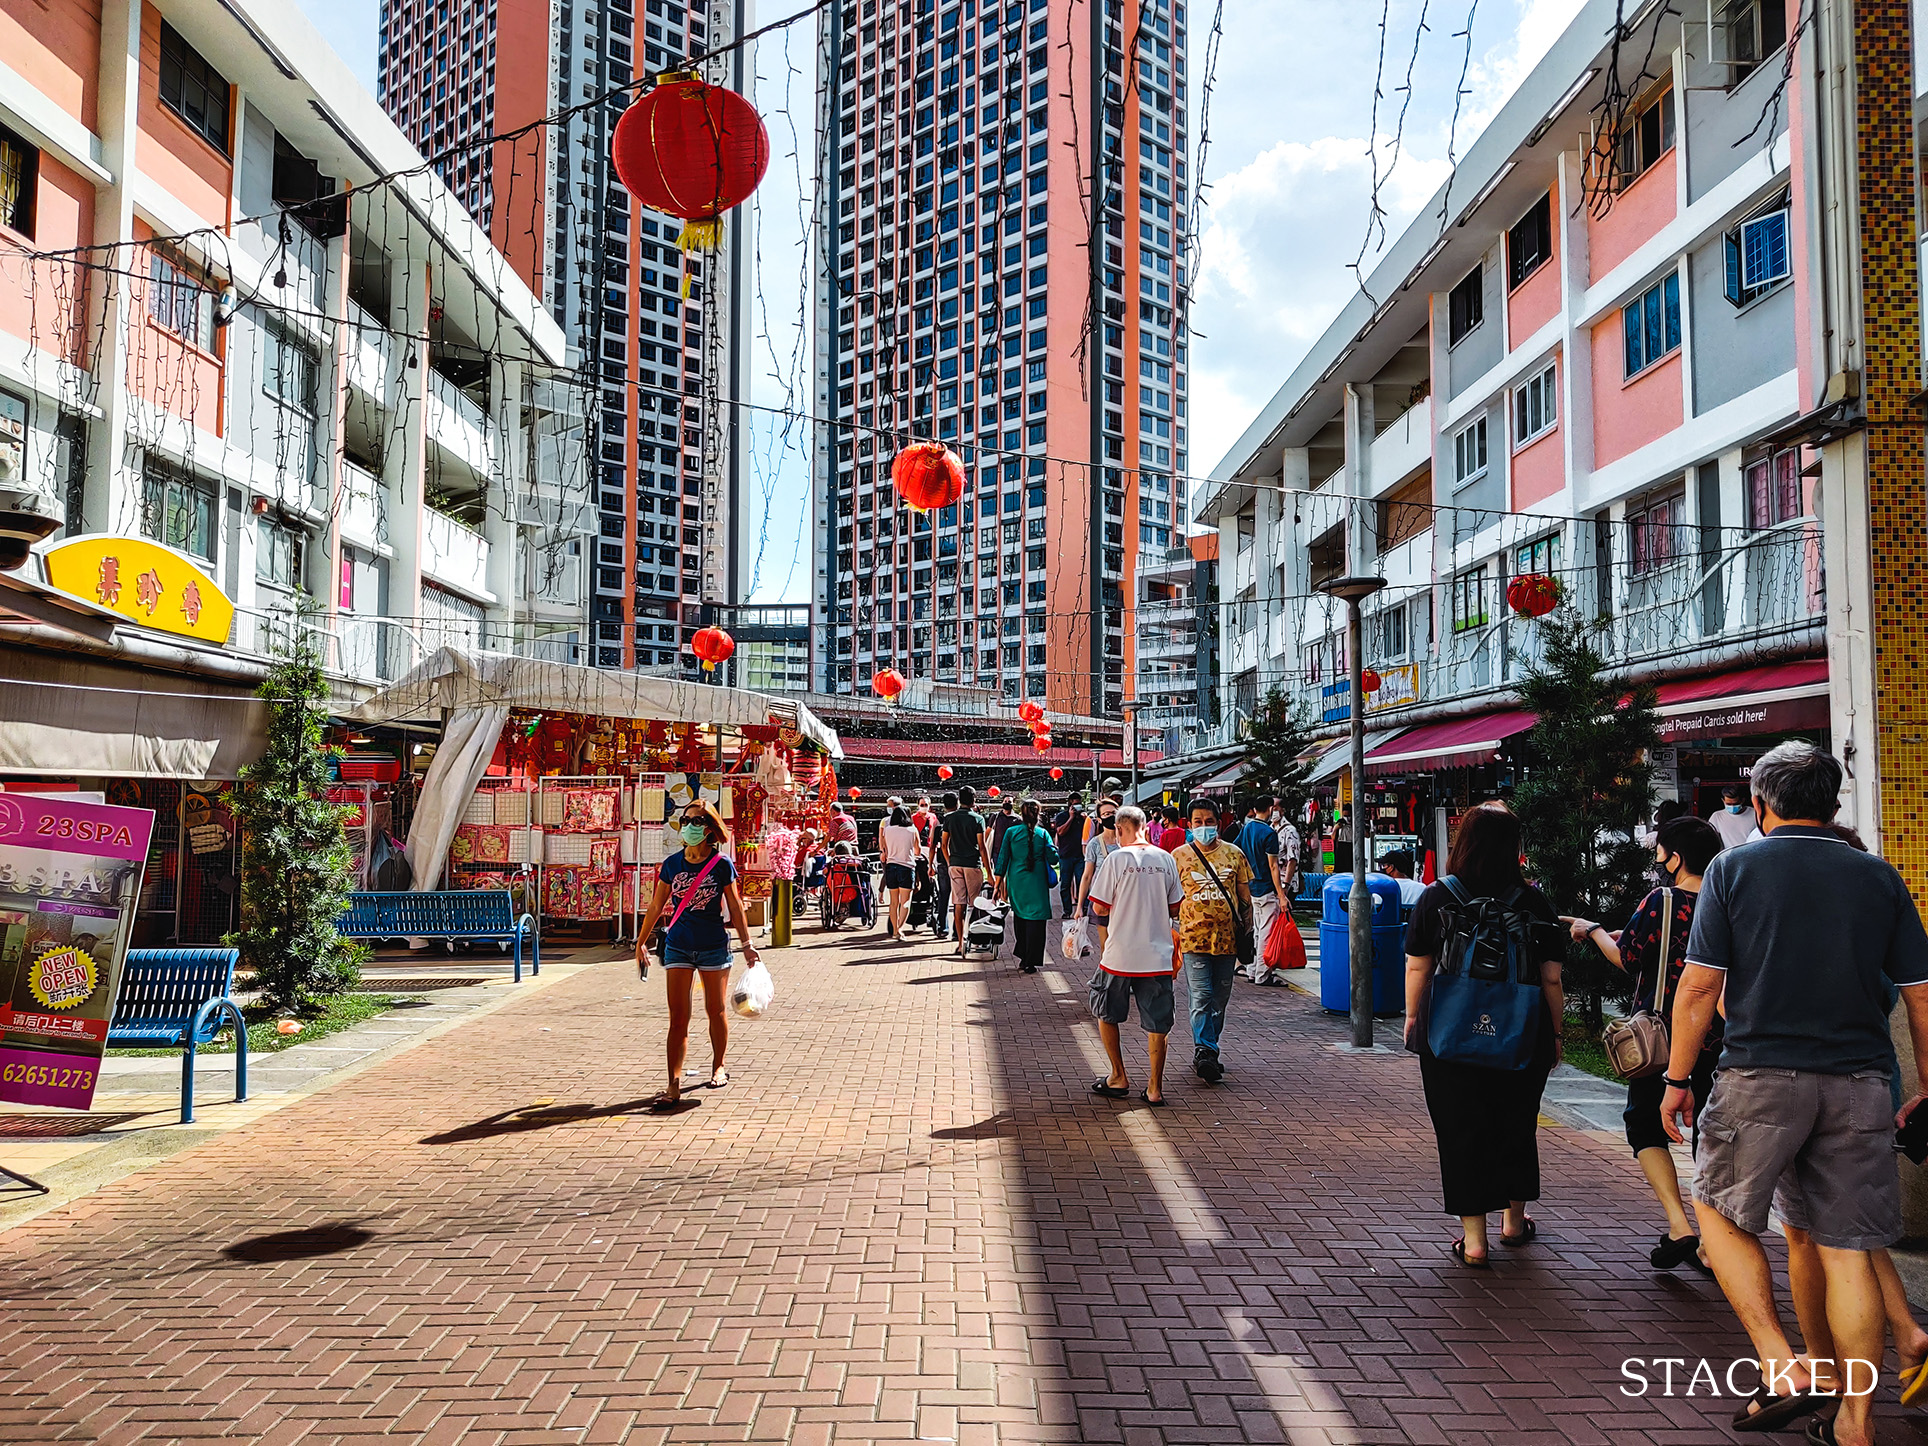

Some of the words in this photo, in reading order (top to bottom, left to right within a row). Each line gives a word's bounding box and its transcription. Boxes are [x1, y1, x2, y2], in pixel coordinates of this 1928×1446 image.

[22, 505, 41, 513] POLICE
[1675, 717, 1702, 732] Prepaid
[1703, 714, 1725, 728] Cards
[1726, 711, 1744, 724] sold
[1744, 708, 1767, 723] here!
[37, 815, 133, 846] 23SPA
[42, 951, 77, 974] NEW
[40, 966, 88, 992] OPEN
[49, 984, 90, 1003] 新开张
[13, 1013, 85, 1032] 请后门上二楼
[1472, 1022, 1497, 1032] SZAN
[40, 1027, 54, 1036] door
[61, 1030, 82, 1039] second
[82, 1031, 97, 1040] floor
[3, 1063, 93, 1091] 62651273
